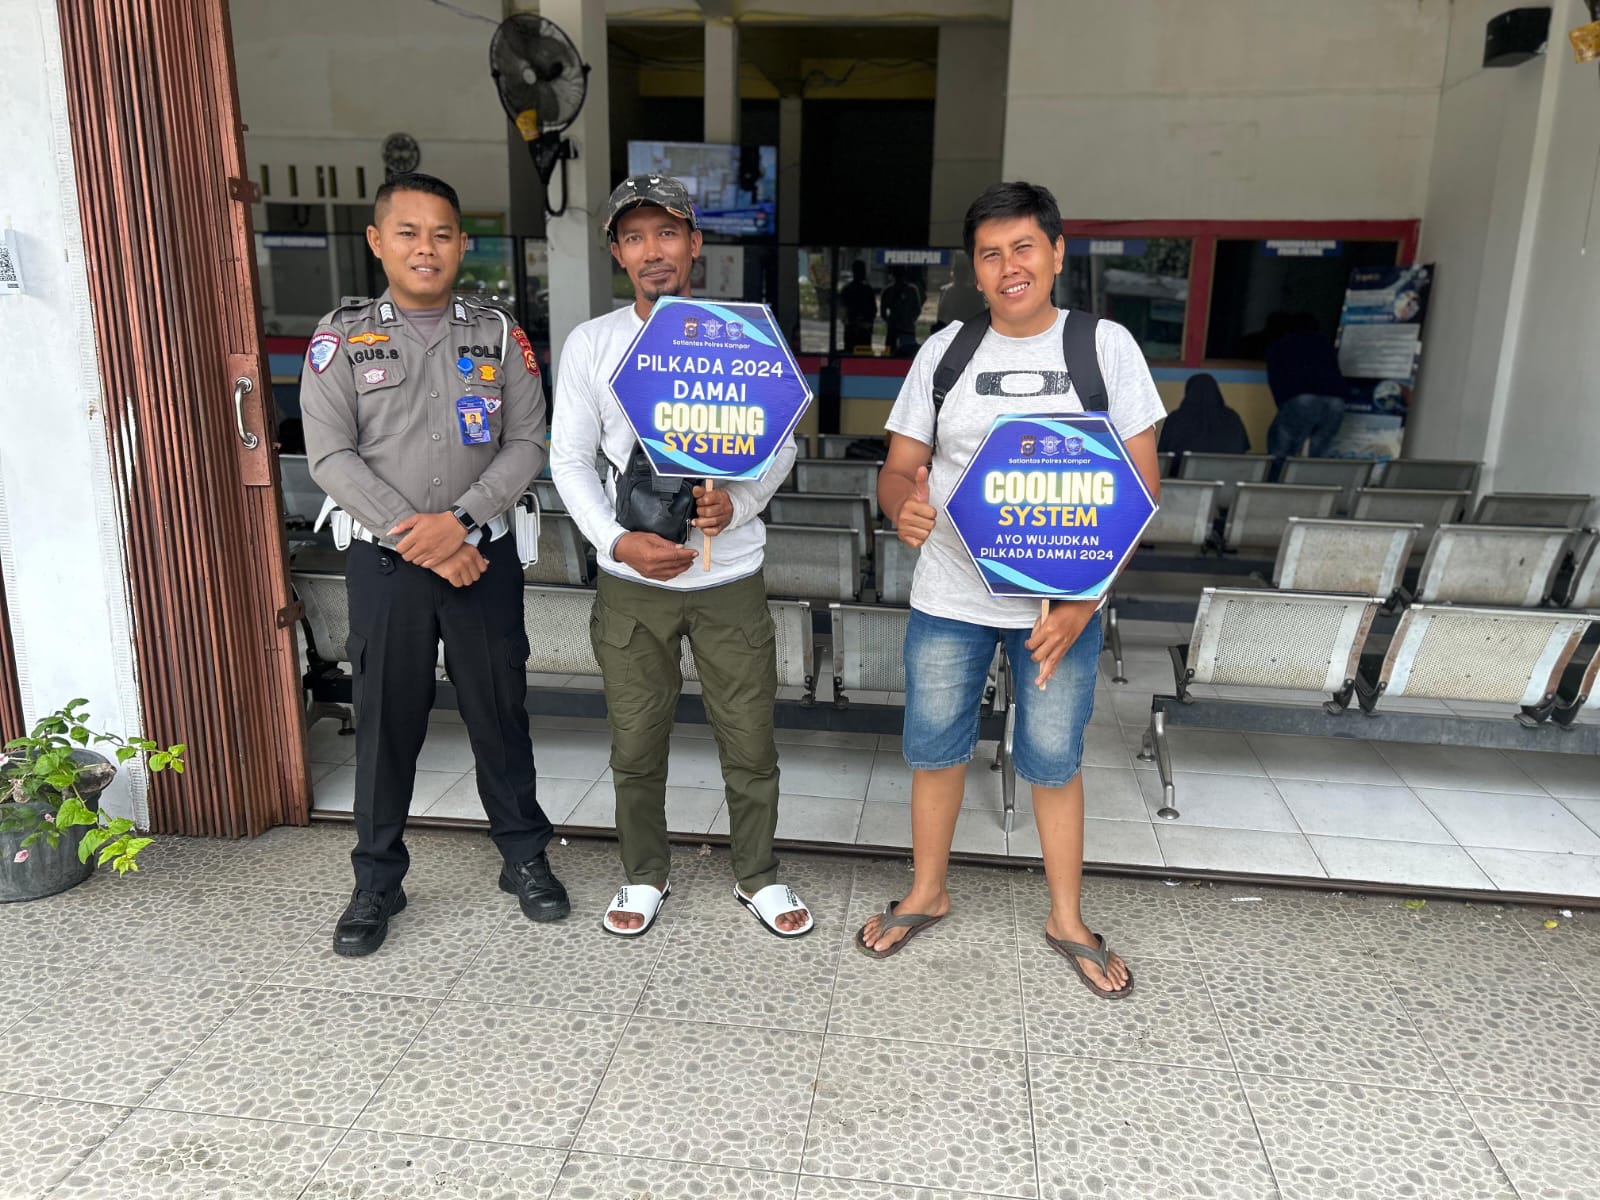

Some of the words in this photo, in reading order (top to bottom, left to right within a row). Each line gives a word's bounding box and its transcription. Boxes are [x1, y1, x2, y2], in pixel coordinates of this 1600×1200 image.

[672, 339, 703, 347] Satlantas
[704, 340, 724, 348] Polres
[724, 341, 751, 350] Kampar
[637, 354, 725, 375] PILKADA
[731, 359, 784, 378] 2024
[673, 380, 746, 402] DAMAI
[653, 401, 765, 436] COOLING
[662, 431, 756, 456] SYSTEM
[1063, 457, 1092, 466] Kampar
[984, 470, 1115, 506] COOLING
[998, 505, 1098, 527] SYSTEM
[995, 534, 1023, 545] AYO
[1026, 534, 1099, 546] WUJUDKAN
[980, 547, 1034, 559] PILKADA
[1037, 548, 1077, 560] DAMAI
[1080, 550, 1114, 561] 2024
